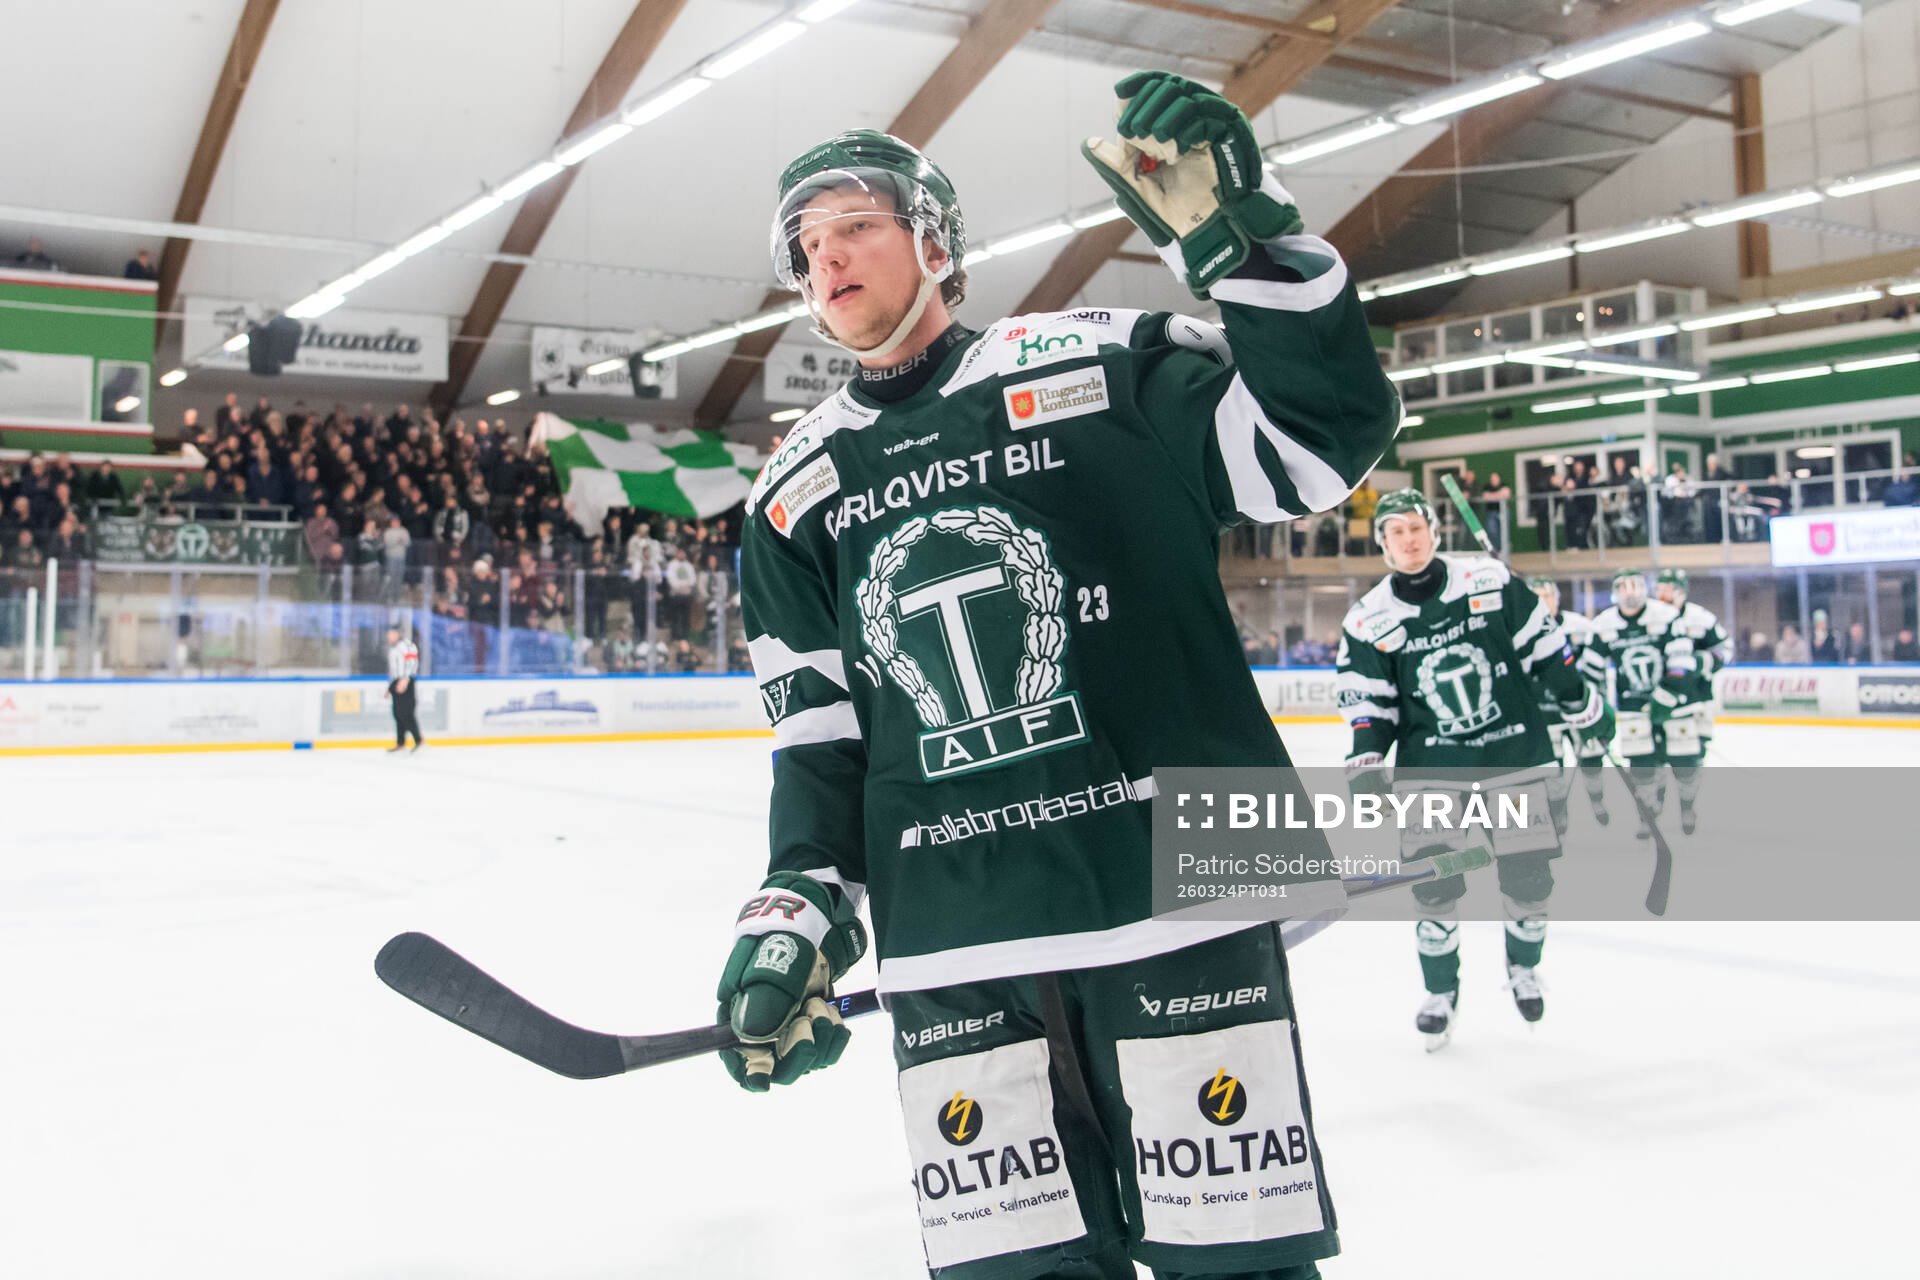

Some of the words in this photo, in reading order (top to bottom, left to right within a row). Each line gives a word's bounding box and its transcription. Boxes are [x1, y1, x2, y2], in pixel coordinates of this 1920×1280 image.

[1199, 244, 1234, 278] BAUER
[299, 322, 424, 354] handa
[1034, 376, 1103, 402] Tingsryds
[1040, 391, 1104, 413] kommun
[1004, 438, 1065, 477] BIL
[1077, 585, 1109, 622] 23
[943, 707, 1052, 768] AIF
[1166, 986, 1267, 1016] BAUER
[919, 1010, 1005, 1047] BAUER
[1136, 1125, 1308, 1178] HOLTAB
[1143, 1190, 1192, 1207] Kunskap
[1201, 1190, 1249, 1205] Service
[1259, 1180, 1314, 1200] Samarbete
[951, 1206, 993, 1223] Service
